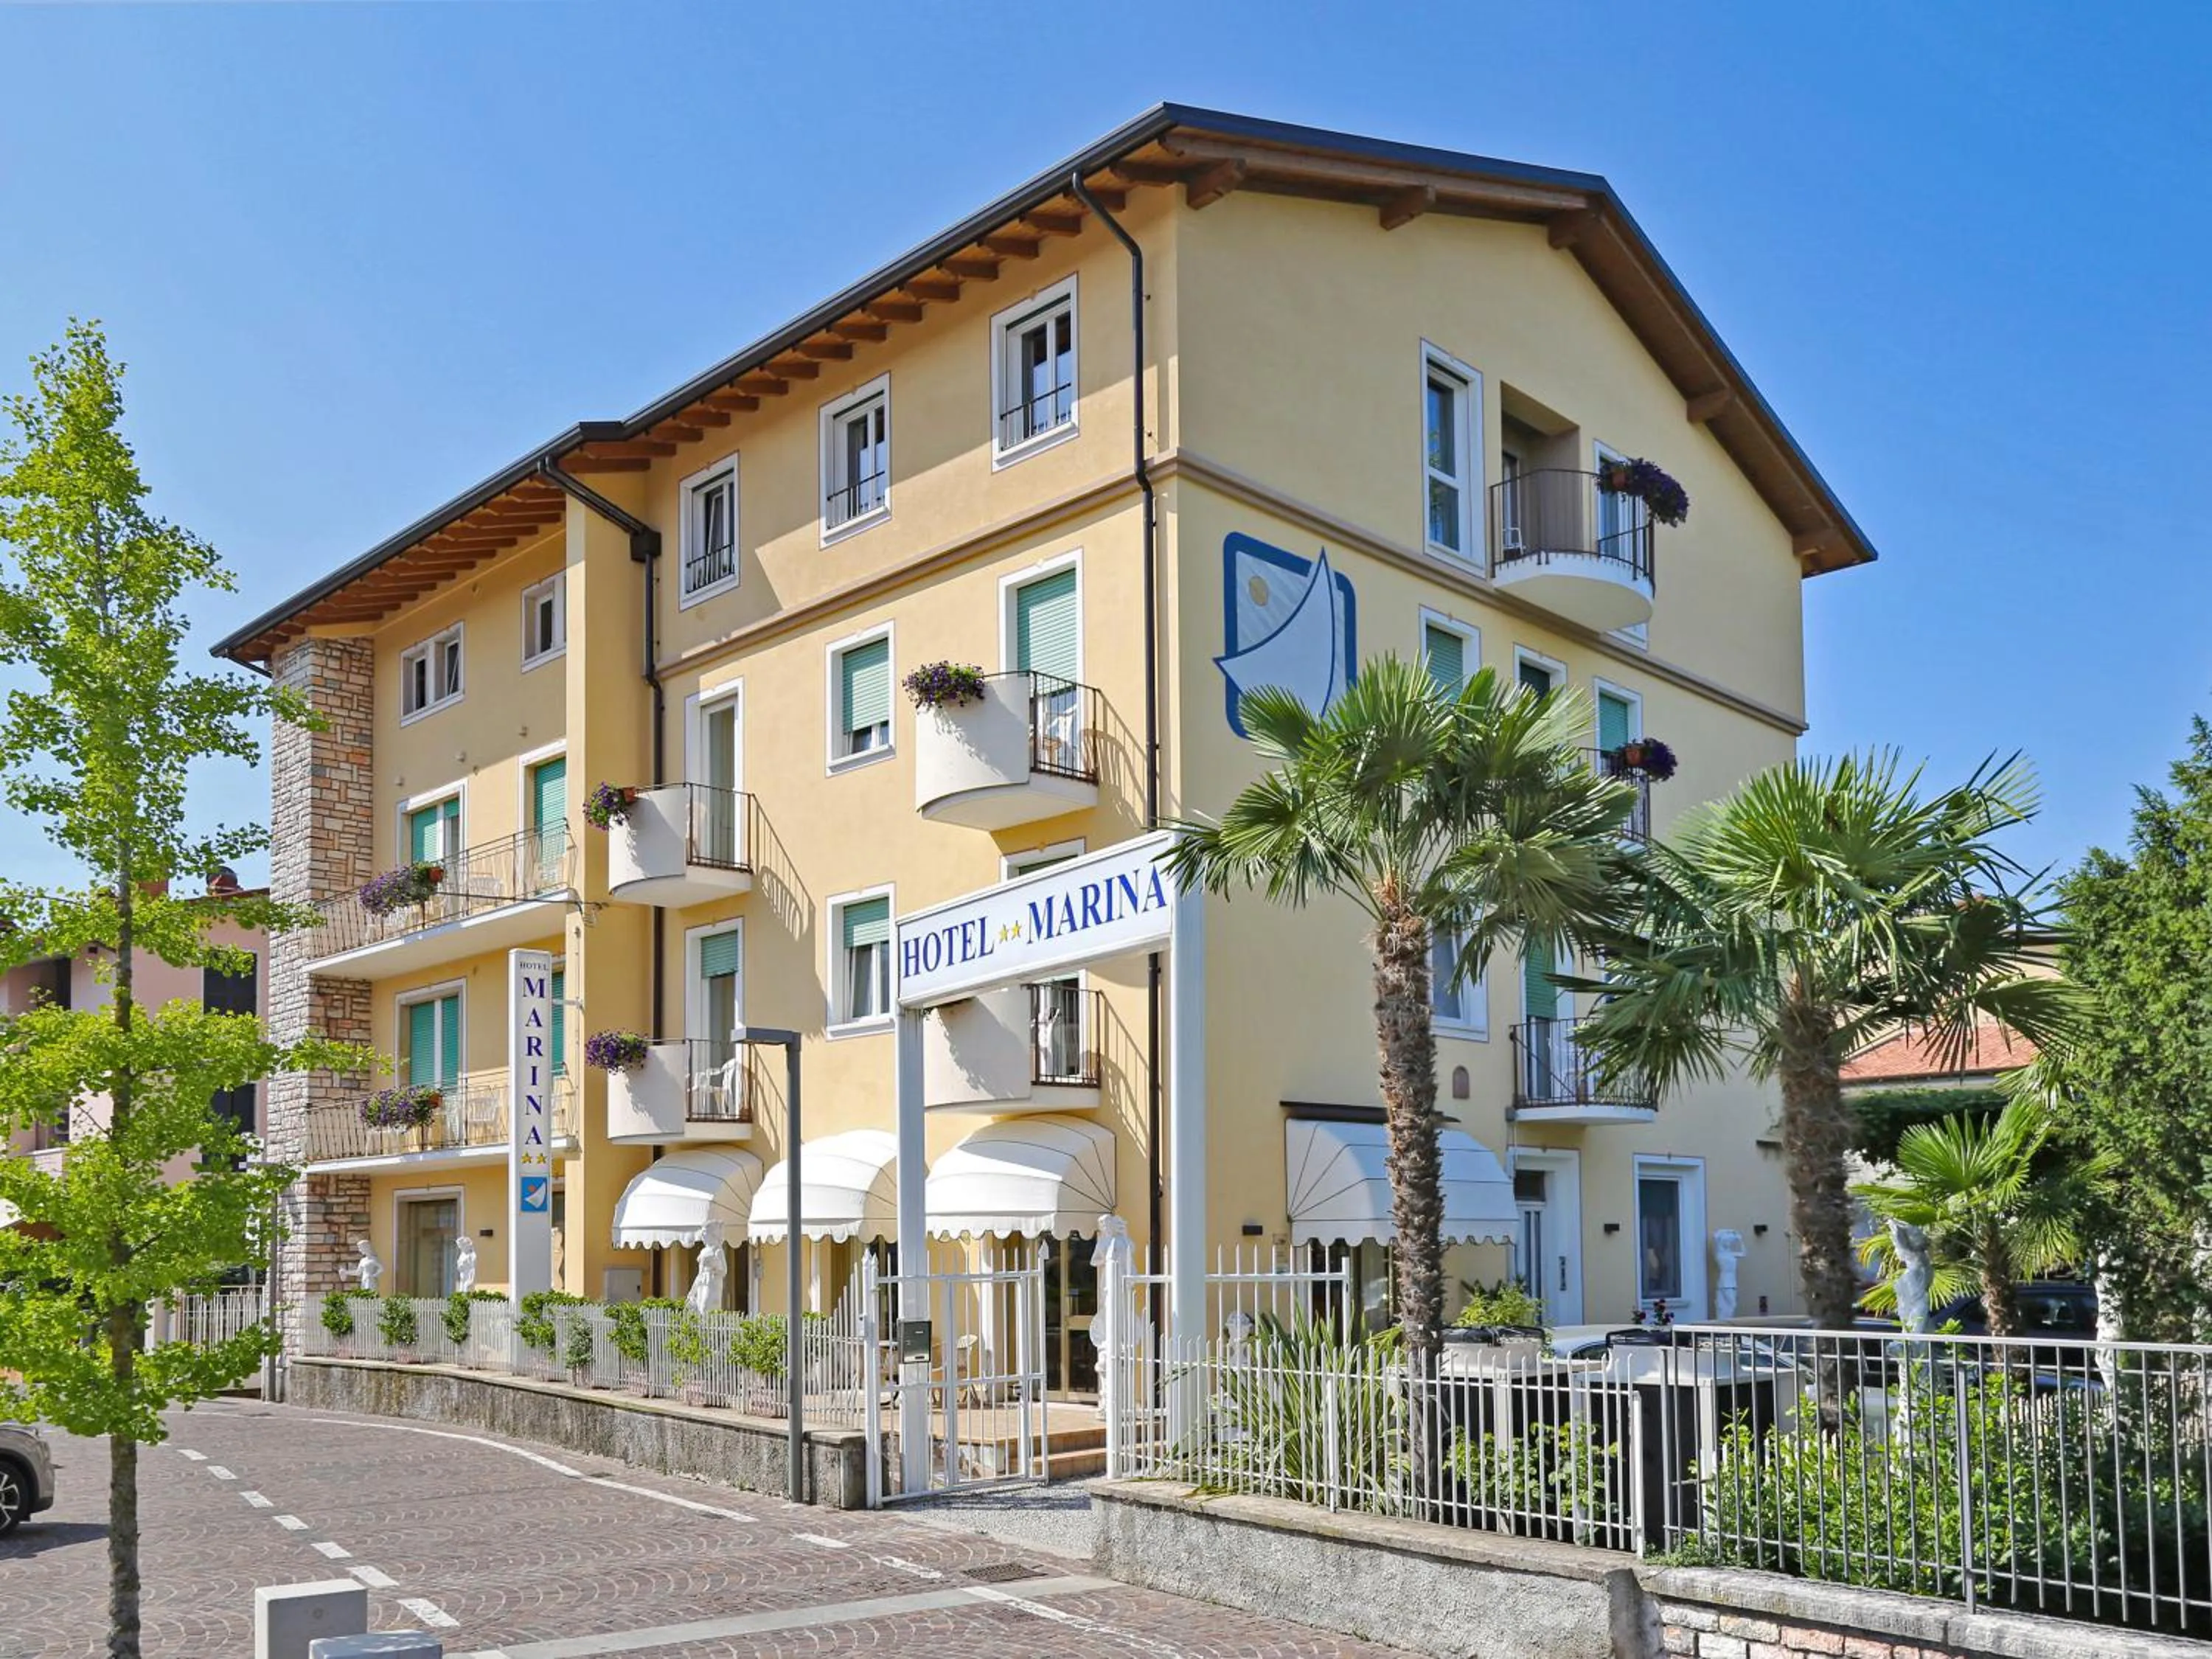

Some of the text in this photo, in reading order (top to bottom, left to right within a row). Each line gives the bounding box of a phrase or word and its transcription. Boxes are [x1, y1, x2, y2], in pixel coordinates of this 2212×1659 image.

[520, 961, 549, 971] HOTEL
[902, 863, 1167, 978] HOTEL MARINA
[523, 977, 545, 1145] MARINA
